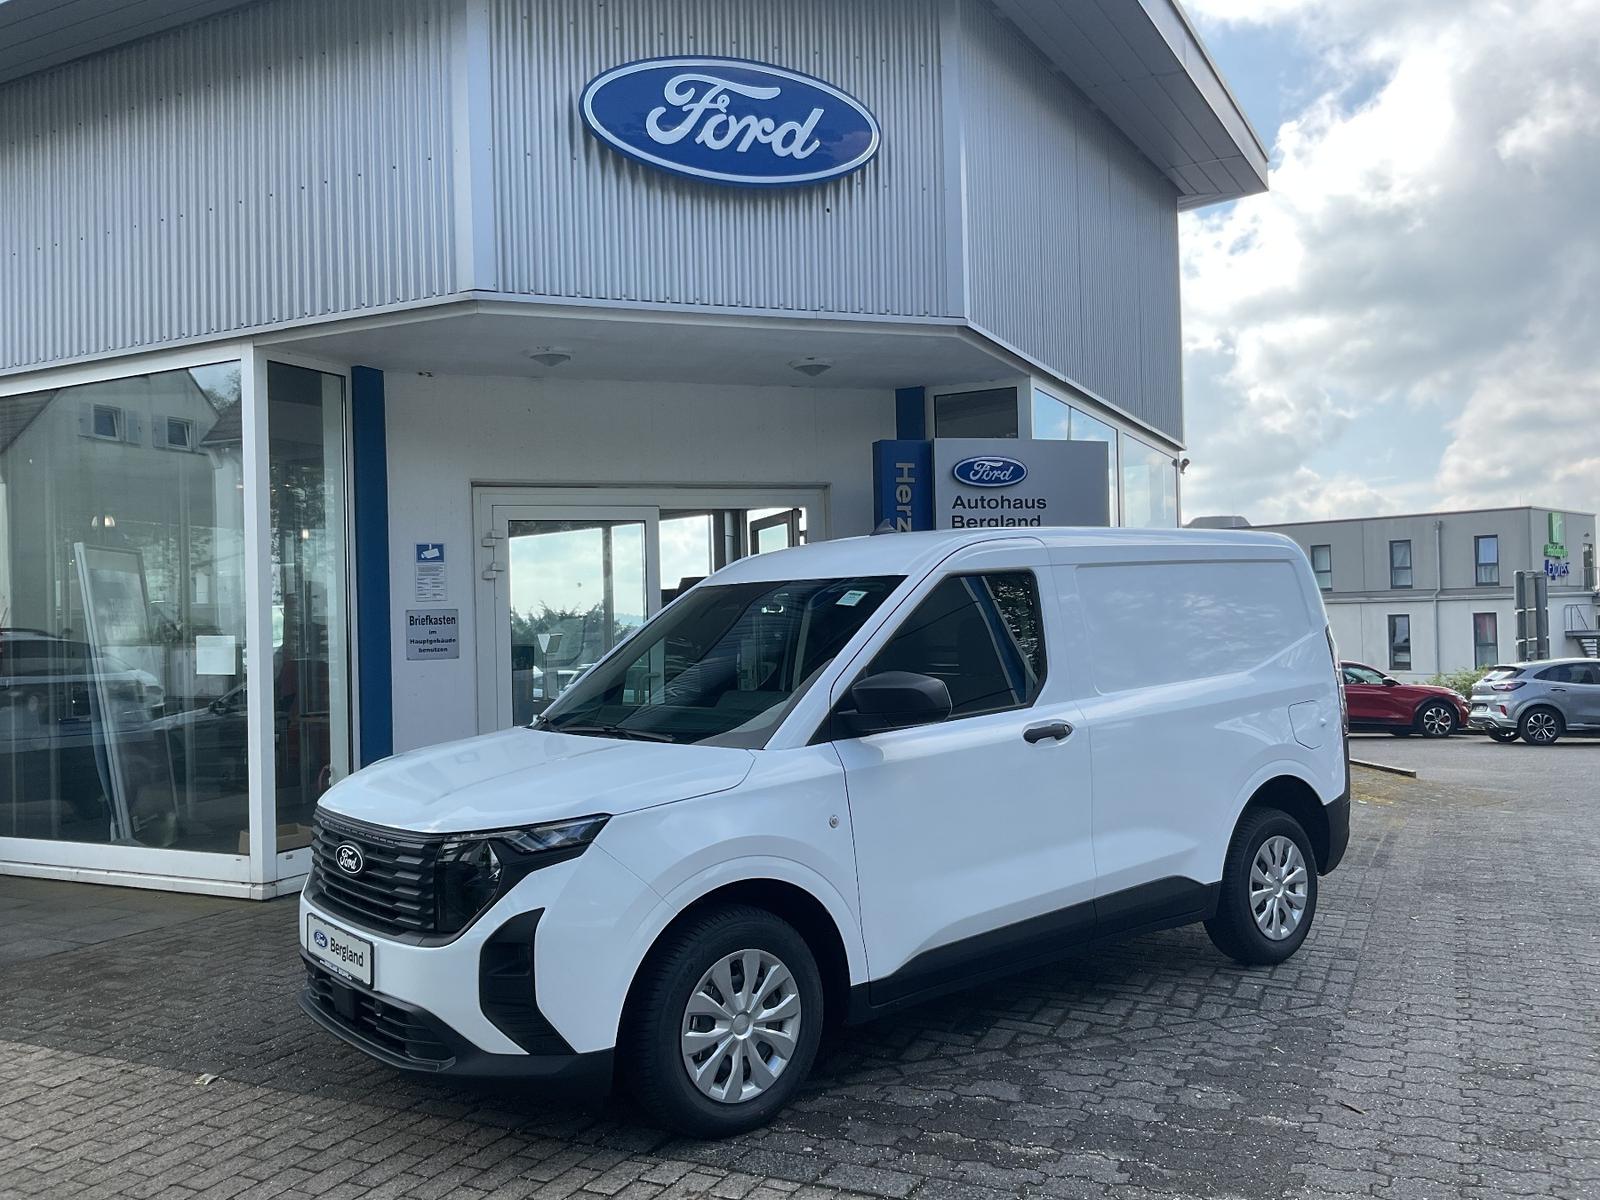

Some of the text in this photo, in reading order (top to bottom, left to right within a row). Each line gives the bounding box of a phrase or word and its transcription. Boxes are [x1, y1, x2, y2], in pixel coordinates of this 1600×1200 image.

[646, 73, 824, 159] Ford
[969, 460, 1014, 481] Ford
[952, 495, 1047, 510] Autohaus
[952, 515, 1041, 528] Bergland
[409, 615, 456, 626] Briefkasten
[339, 848, 357, 870] Ford
[330, 937, 364, 967] Bergland
